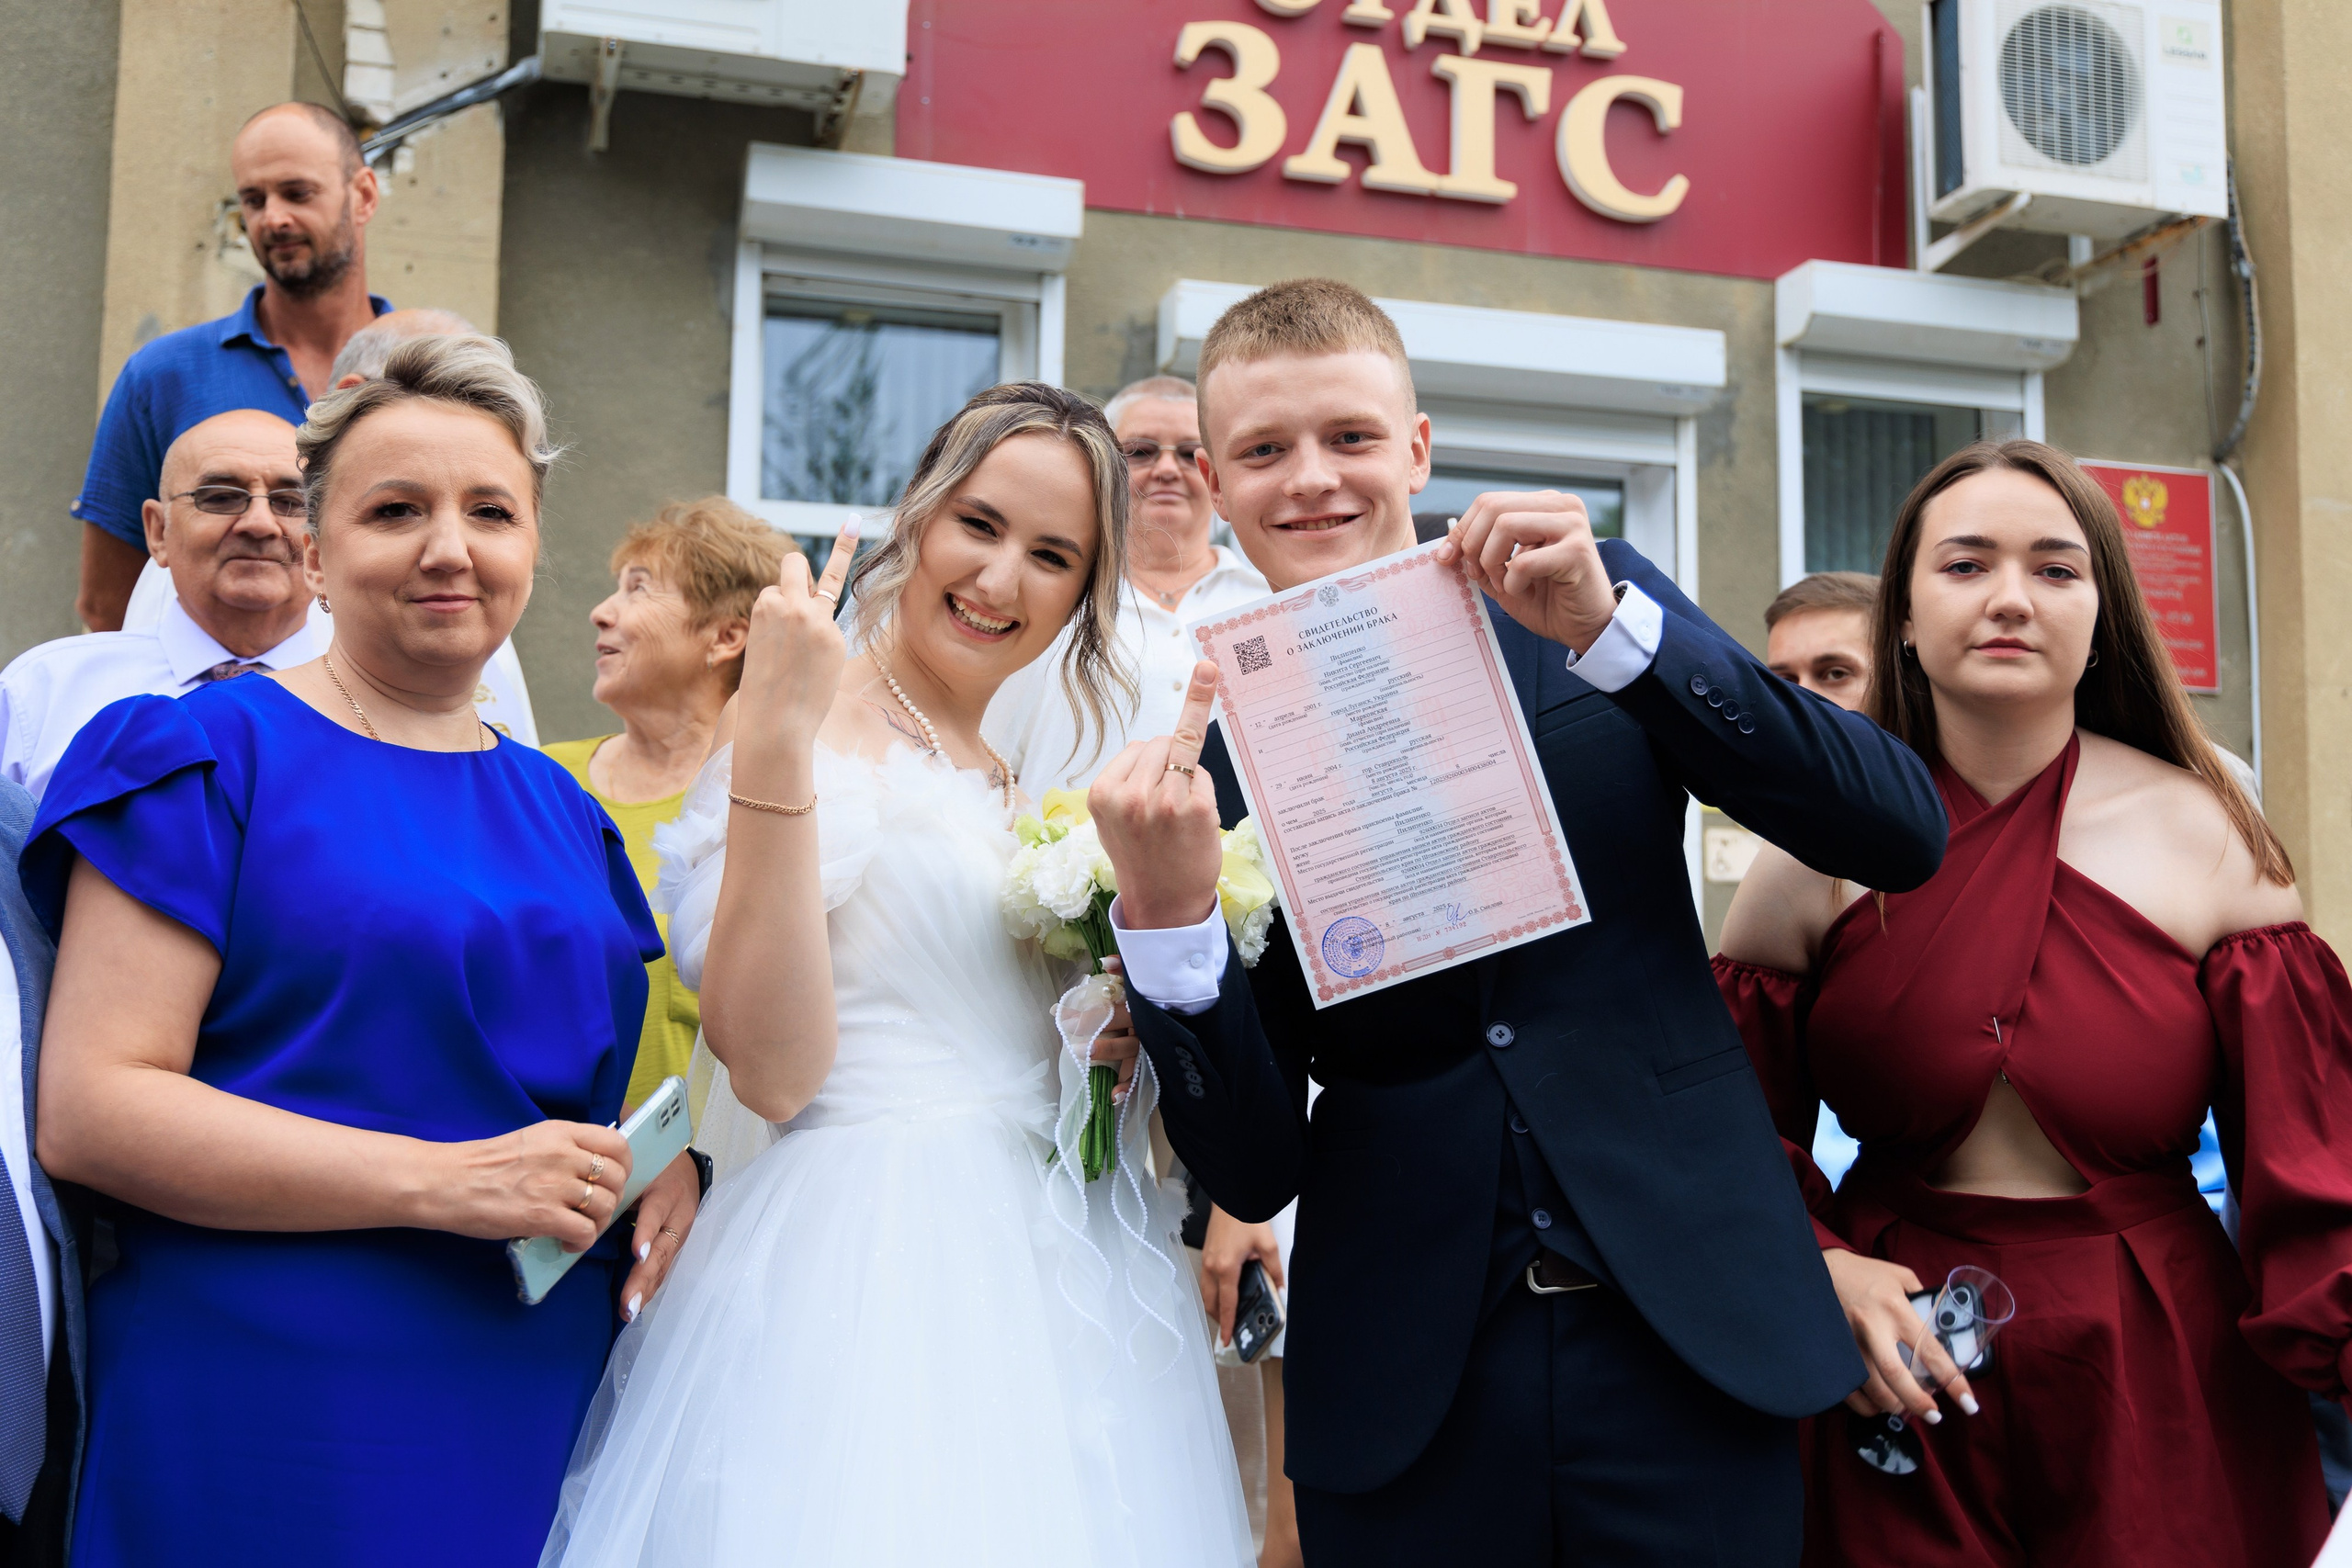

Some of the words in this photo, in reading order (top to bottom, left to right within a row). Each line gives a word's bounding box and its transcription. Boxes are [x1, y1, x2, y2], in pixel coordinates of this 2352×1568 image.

[1251, 0, 1627, 60] ДЕЛ
[1170, 19, 1690, 224] ЗАГС
[1285, 647, 1295, 657] О
[1295, 623, 1365, 653] ЗАКЛЮЧЕНИИ
[1365, 612, 1398, 629] БРАКА
[1297, 605, 1378, 640] СВИДЕТЕЛЬСТВО
[1322, 665, 1350, 679] Никита
[1348, 654, 1383, 671] Сергеевич
[1329, 645, 1366, 662] Пилипенко
[1331, 671, 1354, 682] отчество
[1365, 658, 1390, 671] наличии)
[1336, 652, 1363, 667] (фамилия)
[1273, 710, 1295, 722] апреля
[1302, 702, 1317, 712] 2001
[1386, 671, 1413, 685] русский
[1322, 676, 1358, 694] Российская
[1356, 665, 1390, 682] Федерация
[1340, 676, 1376, 693] (гражданство)
[1267, 722, 1282, 730] (дата
[1281, 712, 1308, 727] рождения)
[1379, 672, 1424, 693] (национальность)
[1329, 705, 1349, 717] город
[1347, 697, 1374, 712] Луганск,
[1372, 689, 1399, 703] Украина
[1344, 708, 1362, 718] (место
[1361, 698, 1388, 713] рождения)
[1349, 706, 1388, 724] Марковская
[1345, 728, 1367, 741] Диана
[1366, 716, 1402, 733] Андреевна
[1351, 732, 1375, 744] отчество
[1385, 719, 1411, 732] наличии)
[1357, 714, 1385, 728] (фамилия)
[1343, 738, 1379, 753] Российская
[1377, 727, 1410, 744] Федерация
[1361, 738, 1396, 754] (гражданство)
[1288, 783, 1303, 792] (дата
[1301, 773, 1329, 788] рождения)
[1399, 735, 1445, 754] (национальность)
[1295, 773, 1314, 783] июня
[1323, 763, 1339, 774] 2004
[1408, 733, 1432, 747] русская
[1361, 766, 1374, 775] гор.
[1373, 754, 1410, 772] Ставрополь
[1364, 770, 1383, 780] (место
[1381, 760, 1409, 774] рождения)
[1277, 800, 1311, 816] заключили
[1309, 795, 1326, 805] брак
[1375, 771, 1399, 784] августа
[1397, 765, 1413, 776] 2025
[1284, 818, 1298, 826] чем
[1311, 807, 1328, 818] 2025
[1341, 798, 1356, 807] года
[1371, 786, 1394, 799] августа
[1406, 774, 1429, 786] месяца
[1487, 749, 1507, 758] числа
[1368, 781, 1387, 792] (число,
[1385, 776, 1404, 785] месяц,
[1402, 772, 1414, 780] год)
[1283, 818, 1317, 834] составлена
[1316, 812, 1338, 823] запись
[1337, 807, 1351, 817] акта
[1355, 793, 1393, 810] заключении
[1392, 787, 1411, 798] брака
[1428, 822, 1465, 838] наименование
[1465, 817, 1485, 826] органа,
[1484, 808, 1508, 820] которым
[1289, 843, 1307, 853] После
[1307, 831, 1344, 848] заключения
[1343, 825, 1362, 836] брака
[1361, 815, 1396, 830] присвоены
[1394, 805, 1424, 819] фамилии:
[1292, 851, 1309, 862] мужу
[1393, 810, 1432, 829] Пилипенко
[1295, 859, 1311, 869] жене
[1396, 818, 1434, 836] Пилипенко
[1296, 865, 1315, 875] Место
[1313, 850, 1360, 870] государственной
[1359, 839, 1395, 856] регистрации
[1419, 822, 1444, 837] 92600034
[1442, 818, 1462, 829] Отдел
[1459, 811, 1481, 823] записи
[1479, 806, 1498, 817] актов
[1313, 866, 1351, 884] гражданского
[1350, 857, 1379, 872] состояния
[1377, 847, 1412, 863] управления
[1410, 840, 1431, 852] записи
[1430, 835, 1448, 845] актов
[1446, 823, 1486, 840] гражданского
[1484, 814, 1513, 829] состояния
[1327, 871, 1359, 885] произведена
[1358, 857, 1400, 874] государственная
[1398, 847, 1431, 863] регистрация
[1442, 832, 1476, 847] гражданского
[1476, 822, 1504, 836] состояния)
[1354, 863, 1401, 884] Ставропольского
[1400, 859, 1415, 868] края
[1420, 844, 1460, 862] Шпаковскому
[1458, 838, 1481, 850] району
[1419, 859, 1456, 874] наименование
[1455, 853, 1476, 863] органа,
[1474, 845, 1498, 857] которым
[1497, 840, 1517, 850] выдано
[1306, 896, 1325, 906] Место
[1323, 888, 1346, 900] выдачи
[1344, 876, 1385, 893] свидетельства
[1400, 862, 1426, 874] 92600034
[1424, 857, 1442, 868] Отдел
[1441, 851, 1462, 862] записи
[1461, 845, 1478, 856] актов
[1476, 833, 1516, 852] гражданского
[1319, 901, 1349, 915] состояния
[1347, 891, 1381, 907] управления
[1379, 885, 1400, 896] записи
[1399, 879, 1417, 890] актов
[1415, 867, 1454, 885] гражданского
[1452, 858, 1482, 872] состояния
[1480, 842, 1528, 863] Ставропольского
[1332, 901, 1369, 917] свидетельство
[1372, 886, 1415, 904] государственной
[1413, 875, 1446, 891] регистрации
[1445, 872, 1458, 880] акта
[1456, 861, 1492, 876] гражданского
[1491, 852, 1520, 864] состояния)
[1387, 897, 1403, 907] края
[1408, 882, 1448, 900] Шпаковскому
[1446, 875, 1469, 887] району
[1402, 910, 1425, 922] августа
[1431, 902, 1448, 913] 2025
[1396, 926, 1422, 941] работник)
